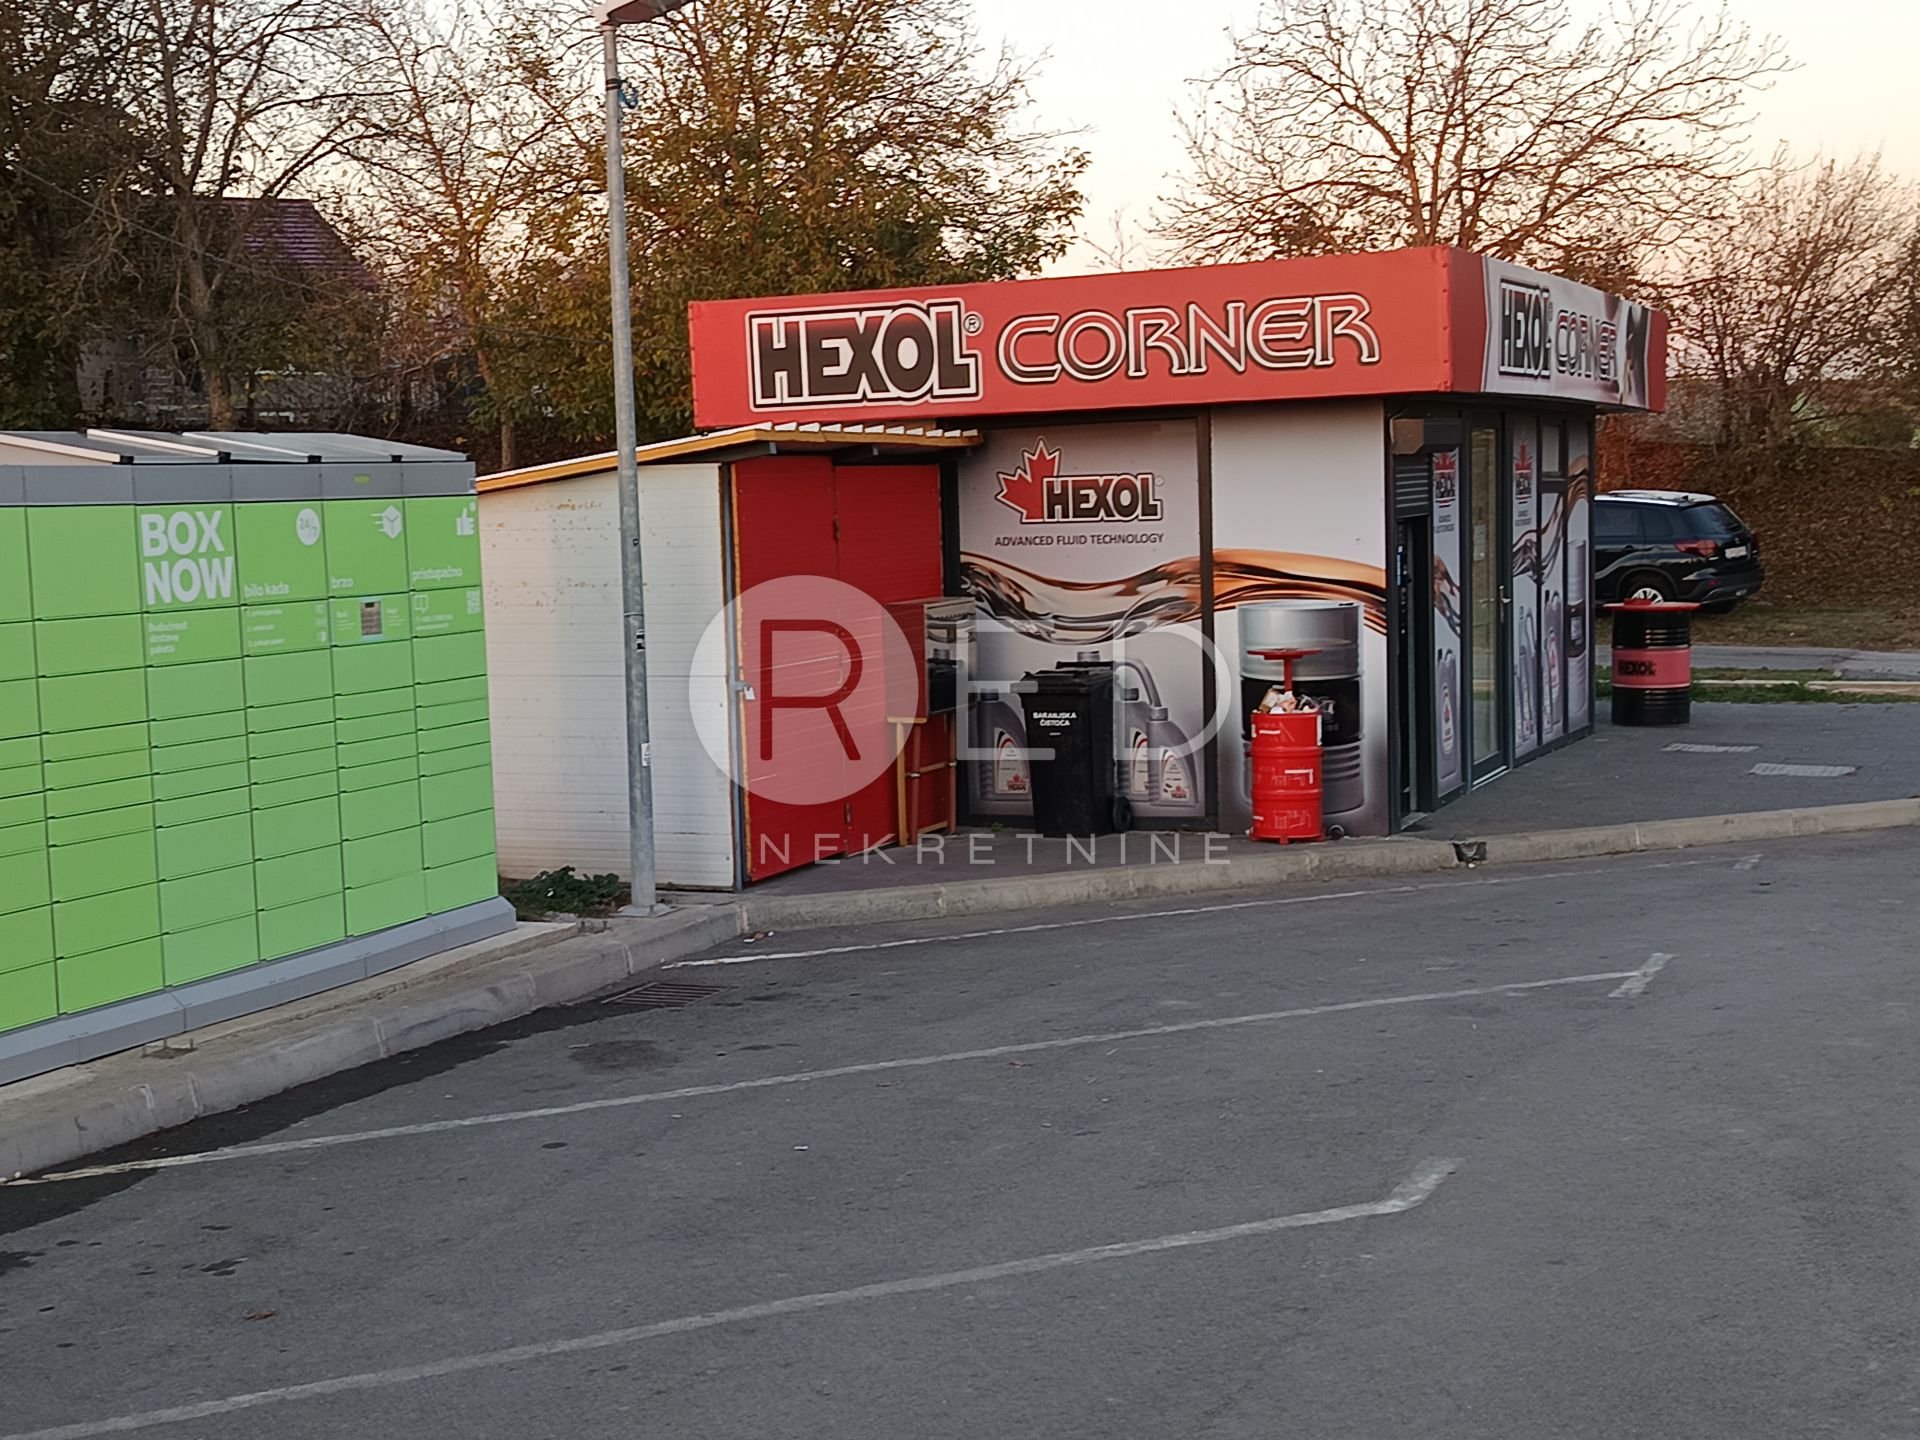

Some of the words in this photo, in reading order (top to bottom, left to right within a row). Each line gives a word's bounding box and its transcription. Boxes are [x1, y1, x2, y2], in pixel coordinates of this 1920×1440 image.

[751, 302, 979, 406] HEXOL
[999, 293, 1381, 384] CORNER
[1500, 279, 1552, 379] HEXOL
[1044, 474, 1163, 522] HEXOL
[140, 510, 225, 557] BOX
[995, 536, 1054, 546] ADVANCED
[1056, 535, 1088, 545] FLUID
[1090, 533, 1164, 544] TECHNOLOGY
[144, 556, 234, 605] NOW
